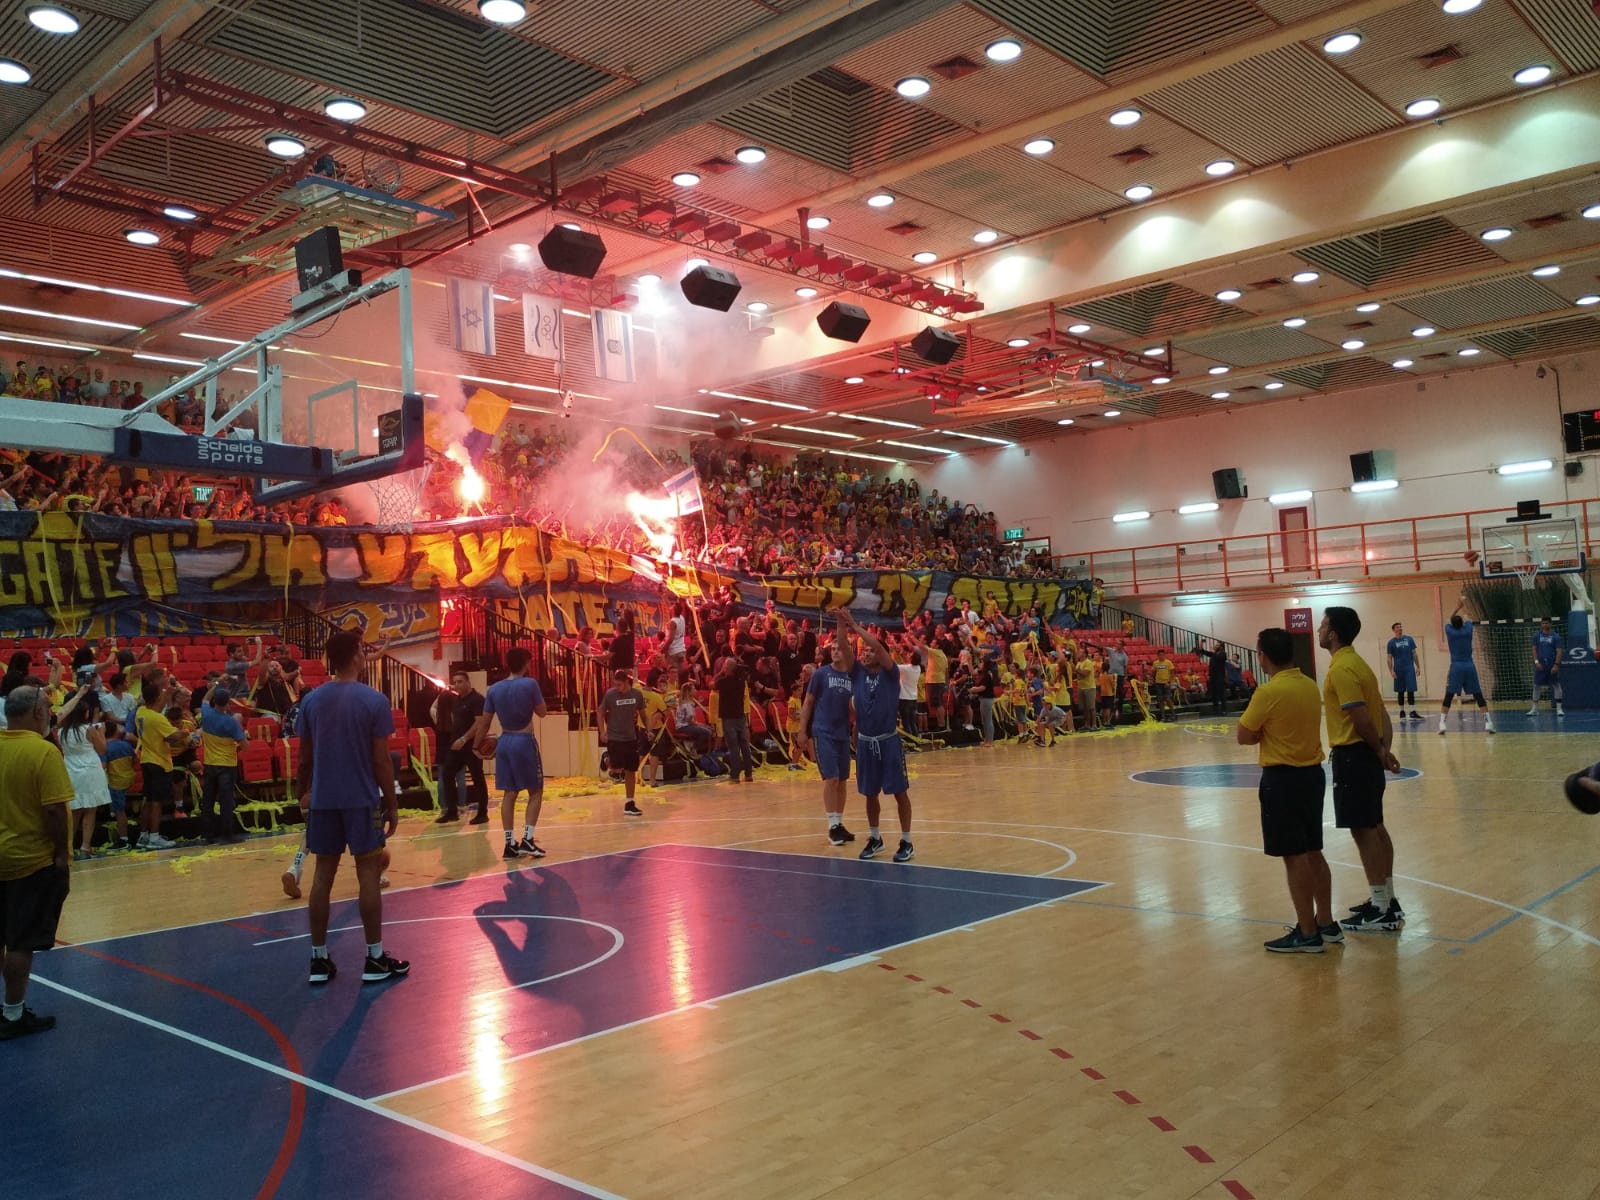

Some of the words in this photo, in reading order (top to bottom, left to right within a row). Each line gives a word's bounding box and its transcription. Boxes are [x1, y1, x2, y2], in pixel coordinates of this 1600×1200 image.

[197, 438, 263, 454] Schelde
[197, 449, 264, 465] Sports
[0, 540, 130, 606] GATE
[494, 591, 615, 640] GATE
